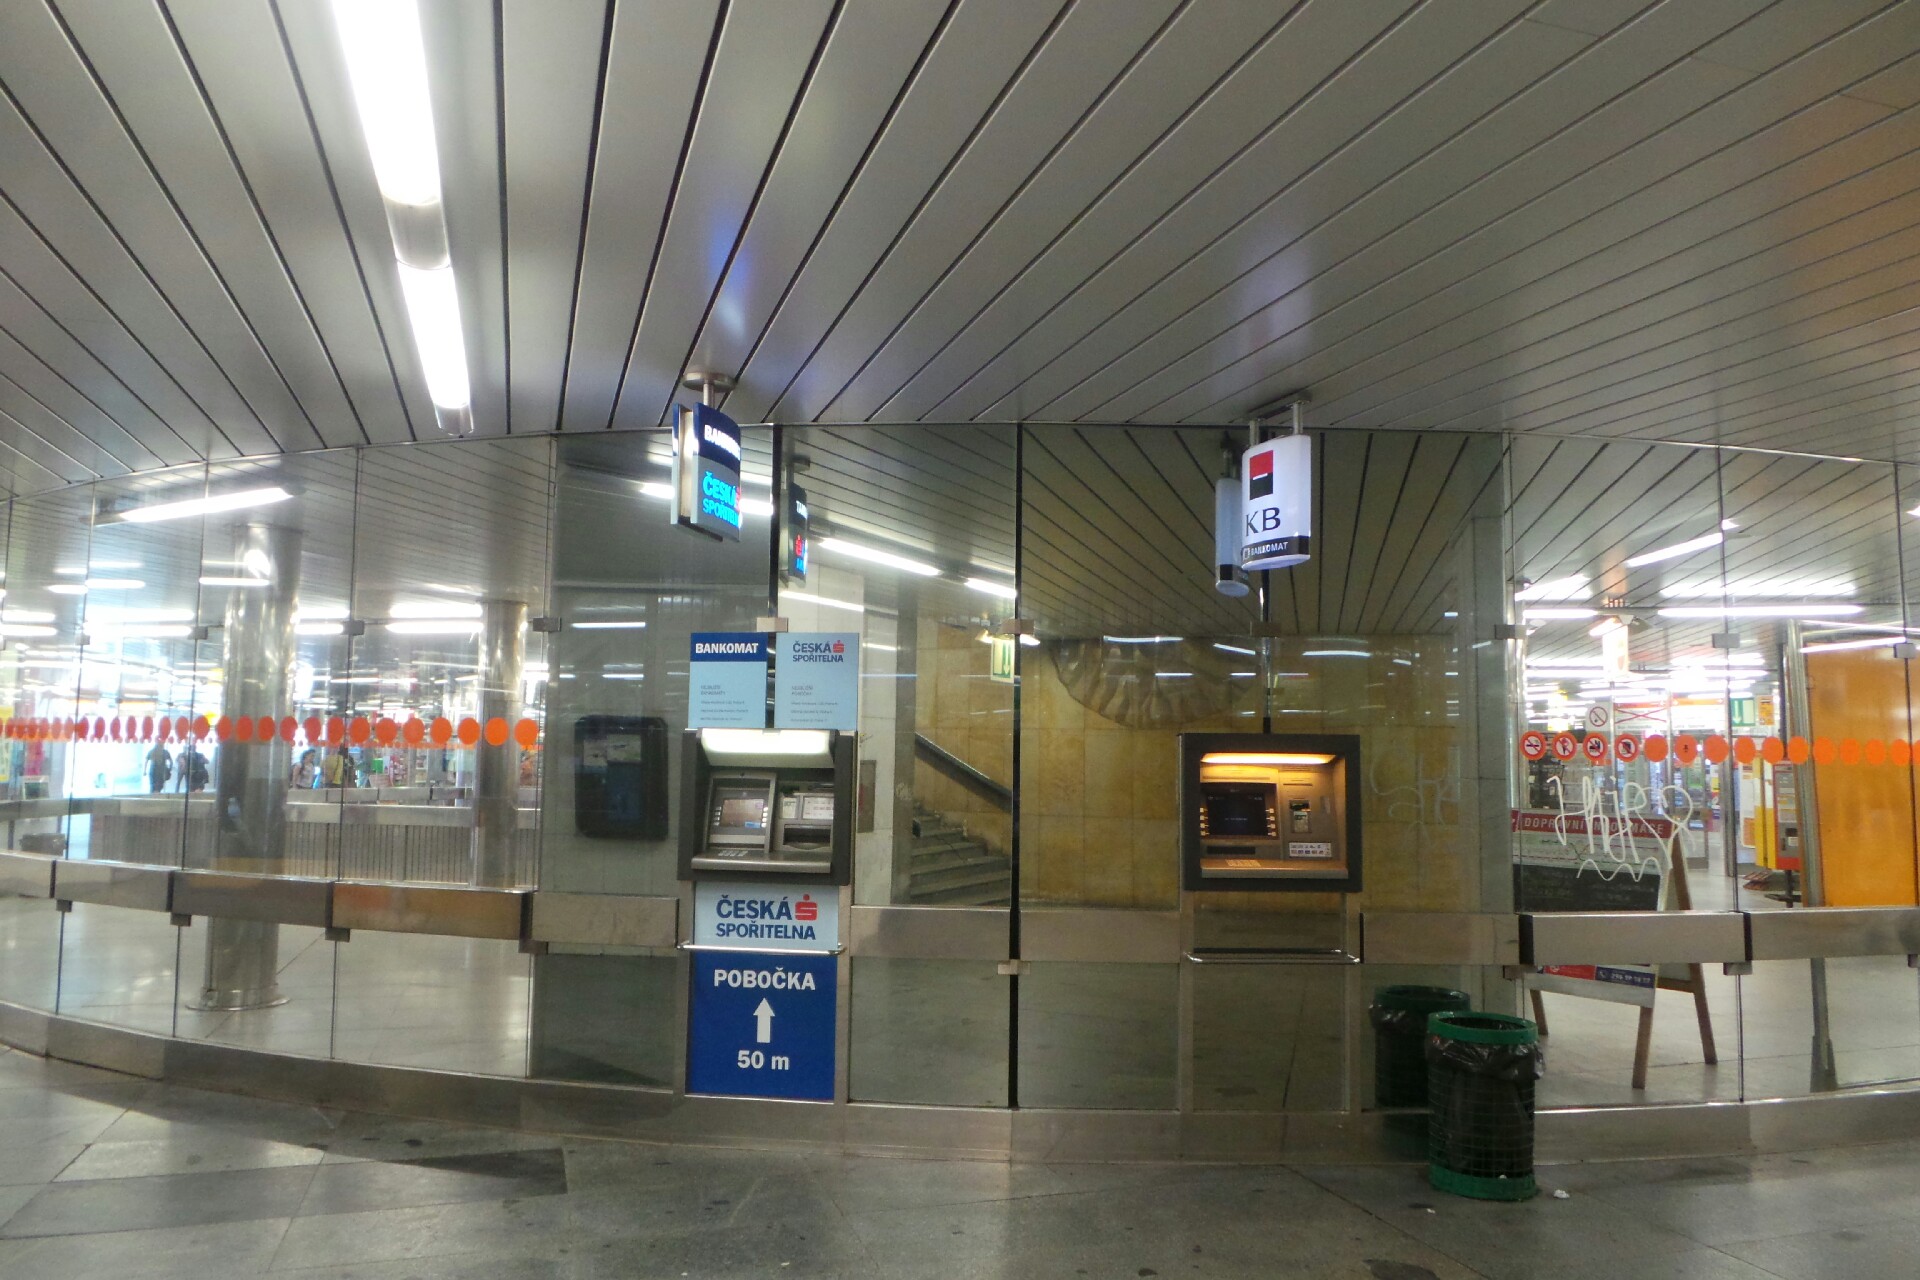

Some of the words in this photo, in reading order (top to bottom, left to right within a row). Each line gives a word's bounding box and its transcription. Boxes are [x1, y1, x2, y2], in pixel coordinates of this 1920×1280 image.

[1245, 507, 1281, 538] KB
[1250, 541, 1289, 556] BANKOMAT
[695, 642, 759, 654] BANKOMAT
[792, 640, 831, 653] ČESKÁ
[792, 654, 844, 663] SPOŘITELNA
[716, 894, 793, 921] ČESKÁ
[716, 921, 816, 940] SPOŘITELNA
[713, 966, 816, 991] POBOČKA
[737, 1049, 765, 1070] 50
[771, 1055, 790, 1071] m
